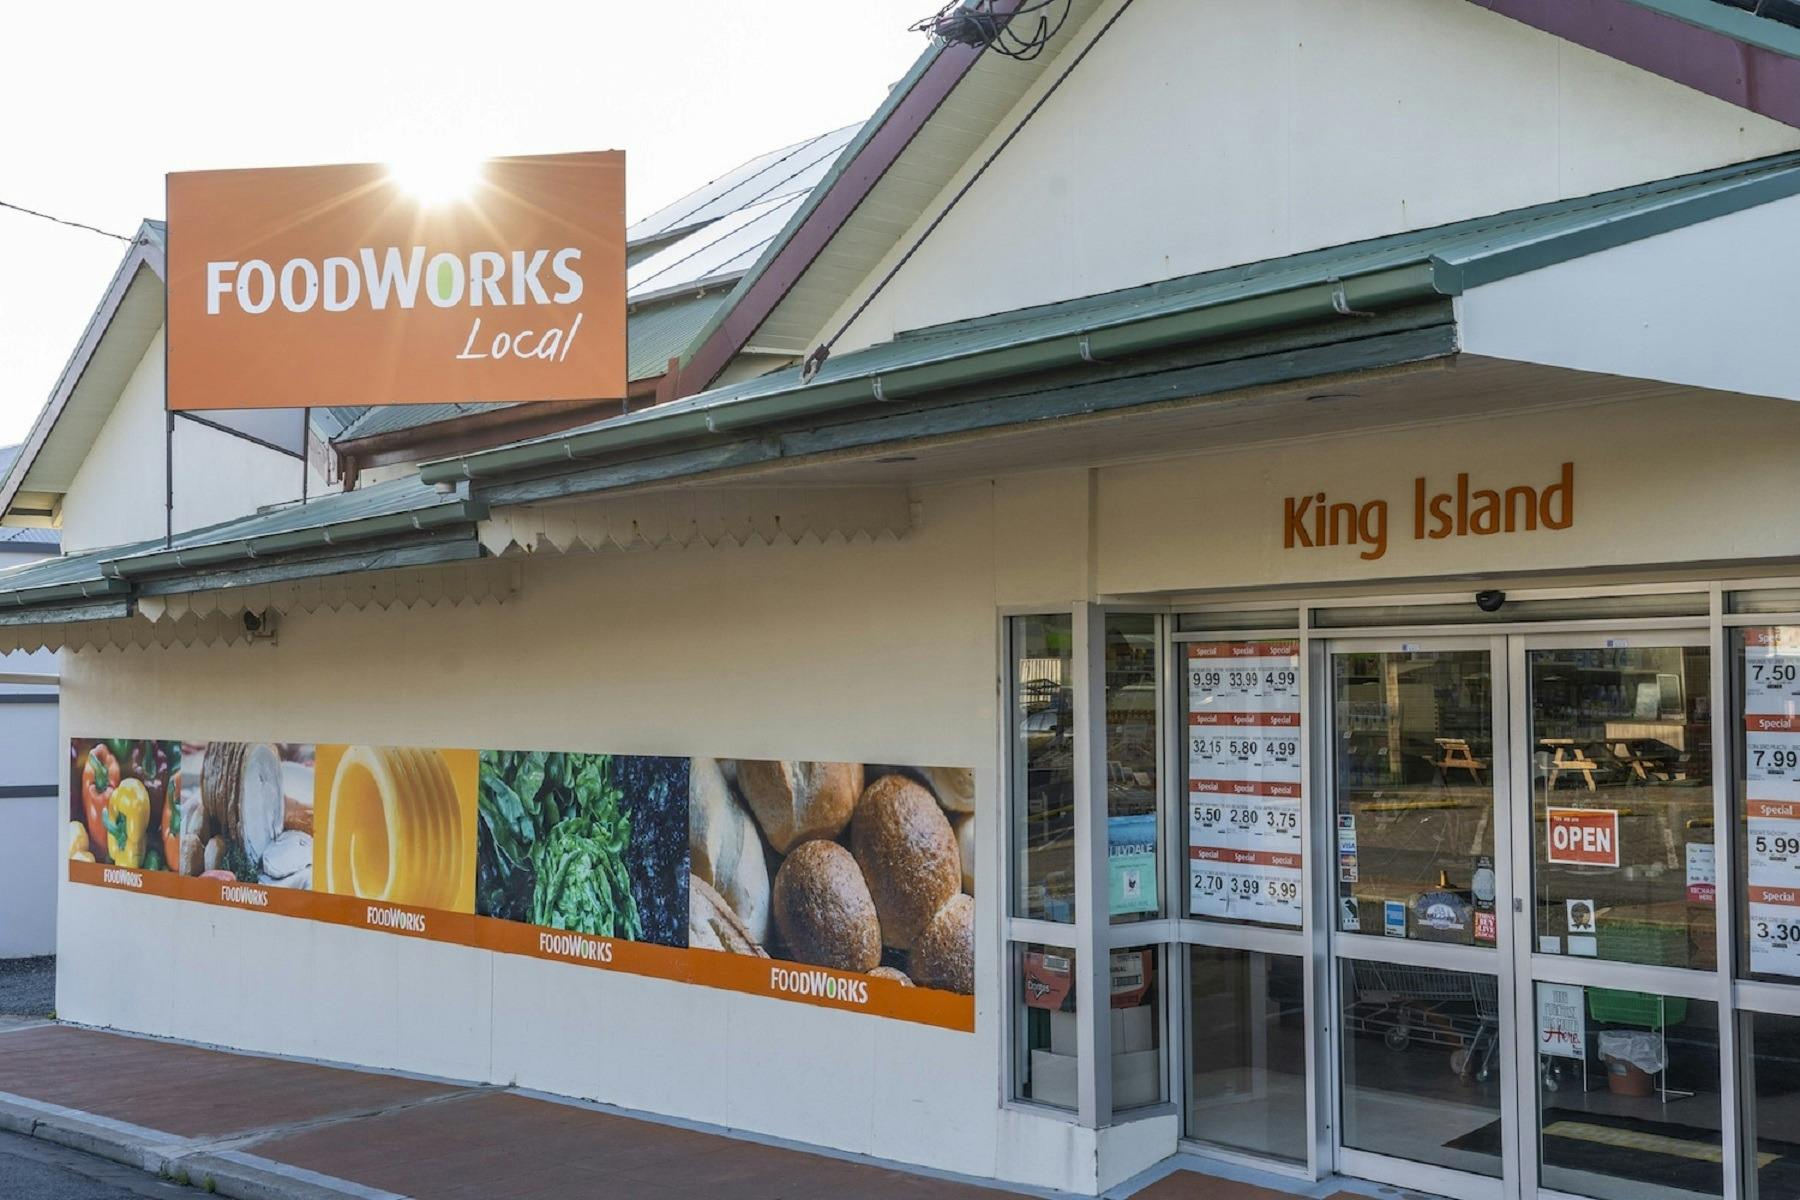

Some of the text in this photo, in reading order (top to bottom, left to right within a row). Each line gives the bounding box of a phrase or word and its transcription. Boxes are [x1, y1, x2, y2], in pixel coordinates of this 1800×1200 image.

[206, 246, 584, 315] FOODWORKS
[456, 312, 584, 363] Local
[1283, 461, 1575, 561] King Island
[1196, 647, 1217, 656] Special
[1232, 646, 1255, 656] Special
[1269, 645, 1291, 655] Special
[1193, 672, 1220, 686] 9.99
[1229, 672, 1258, 687] 33.99
[1265, 671, 1295, 686] 4.99
[1752, 665, 1796, 681] 7.50
[1197, 715, 1218, 724] Special
[1233, 714, 1255, 725] Special
[1270, 715, 1292, 726] Special
[1759, 718, 1792, 731] Special
[1193, 740, 1221, 753] 32.15
[1229, 741, 1258, 755] 5.80
[1266, 742, 1296, 756] 4.99
[1753, 750, 1797, 768] 7.99
[1198, 782, 1219, 792] Special
[1234, 784, 1255, 793] Special
[1270, 786, 1292, 795] Special
[1194, 807, 1221, 822] 5.50
[1230, 809, 1259, 824] 2.80
[1760, 804, 1793, 817] Special
[1267, 811, 1297, 828] 3.75
[1553, 824, 1611, 853] OPEN
[1755, 836, 1800, 855] 5.99
[1198, 849, 1219, 859] Special
[1234, 851, 1256, 862] Special
[1271, 855, 1293, 866] Special
[103, 868, 143, 888] FOODWORKS
[1194, 874, 1223, 890] 2.70
[1230, 877, 1260, 895] 3.99
[1268, 881, 1297, 898] 5.99
[221, 885, 269, 907] FOODWORKS
[1762, 890, 1795, 902] Special
[367, 905, 426, 932] FOODWORKS
[1757, 922, 1800, 942] 3.30
[539, 932, 613, 962] FOODWORKS
[770, 966, 869, 1004] FOODWORKS
